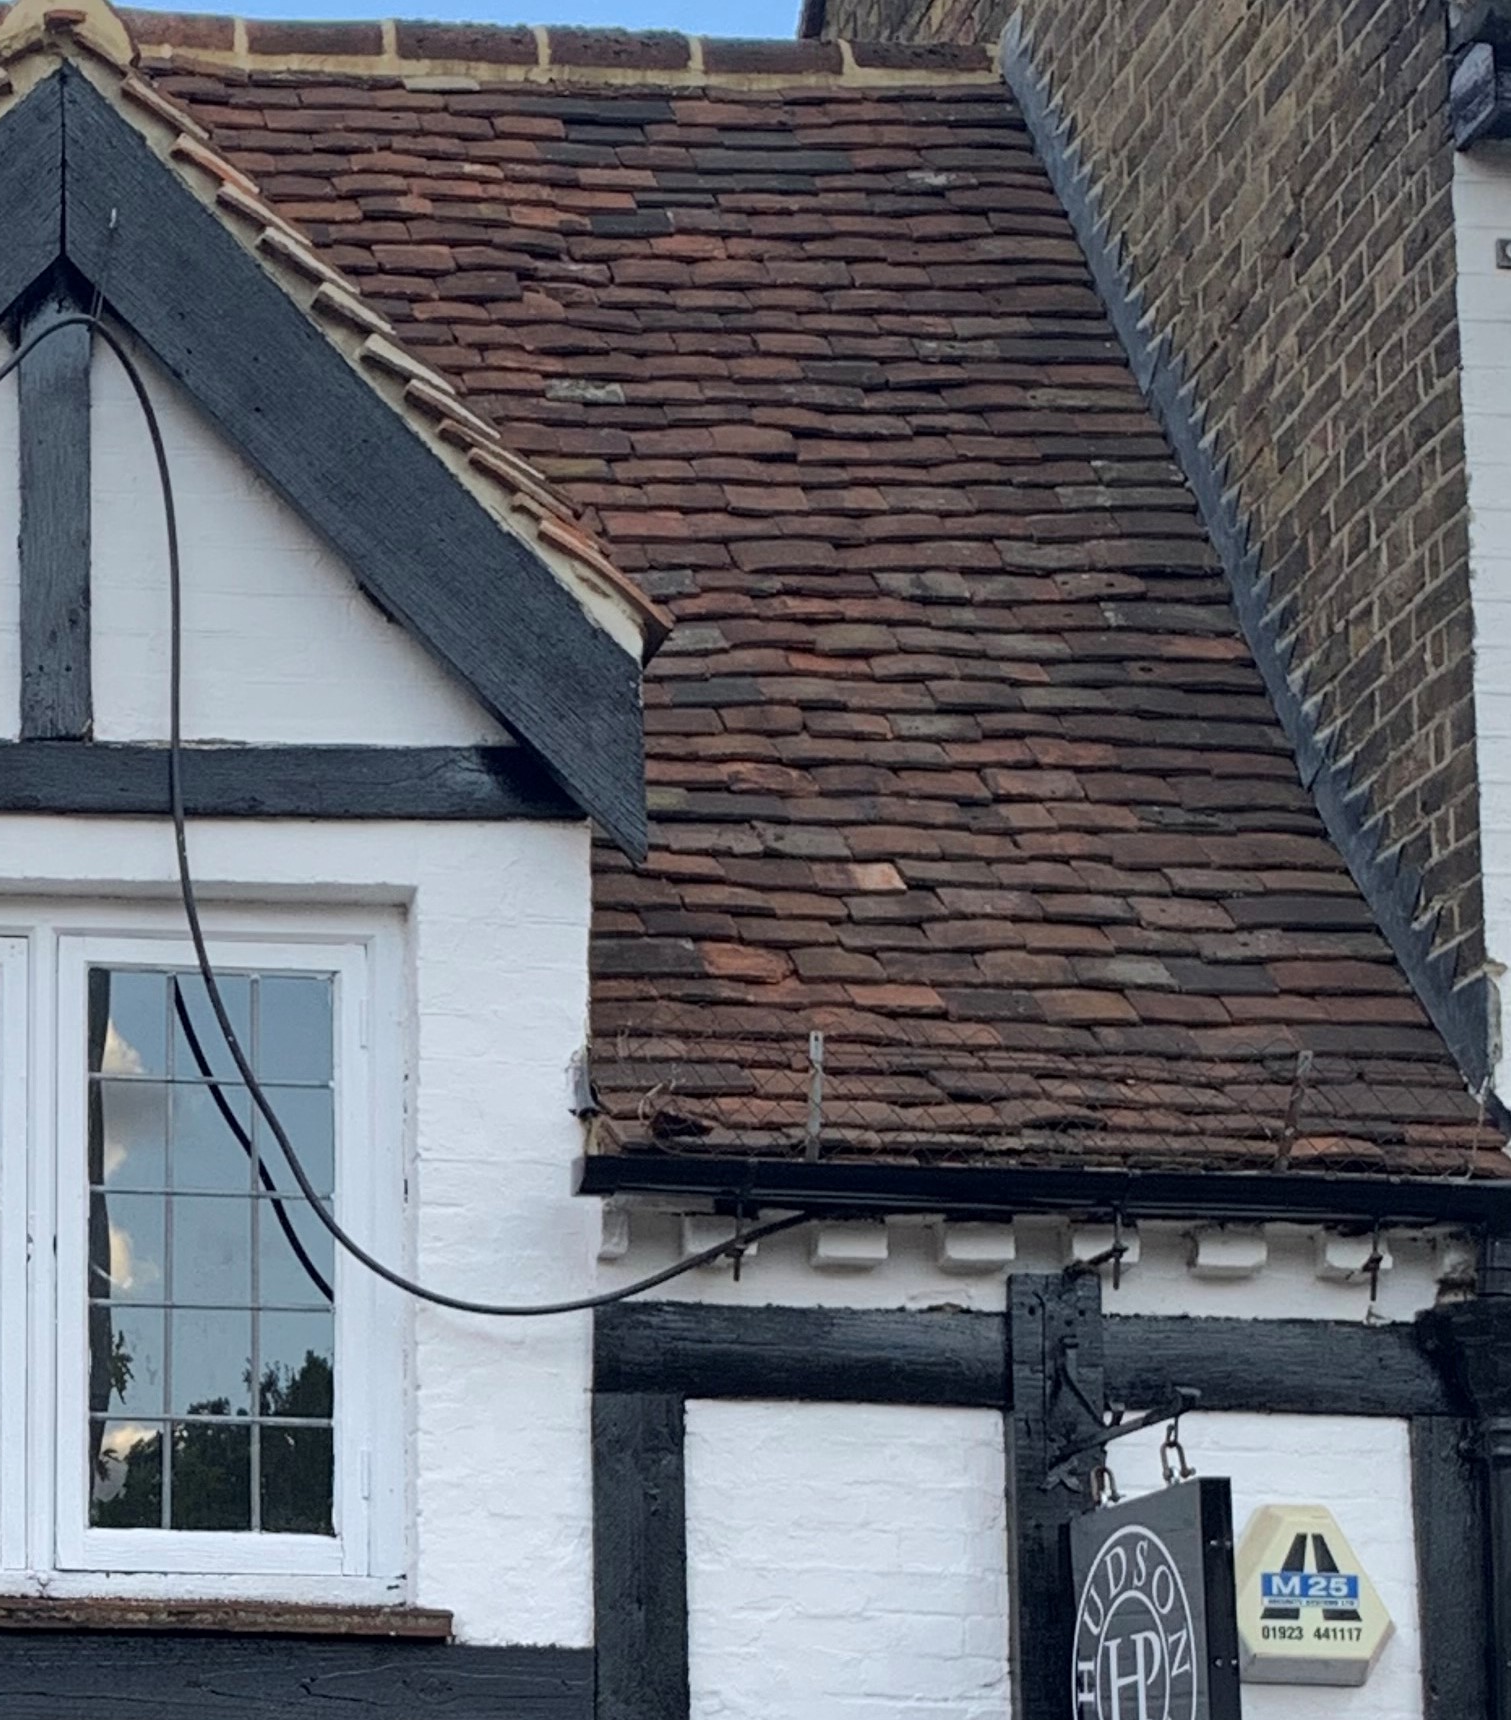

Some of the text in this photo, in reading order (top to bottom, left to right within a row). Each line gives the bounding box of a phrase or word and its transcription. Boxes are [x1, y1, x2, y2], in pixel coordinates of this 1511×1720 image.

[1077, 1540, 1191, 1702] HUDSON
[1261, 1625, 1363, 1642] 01923 441117
